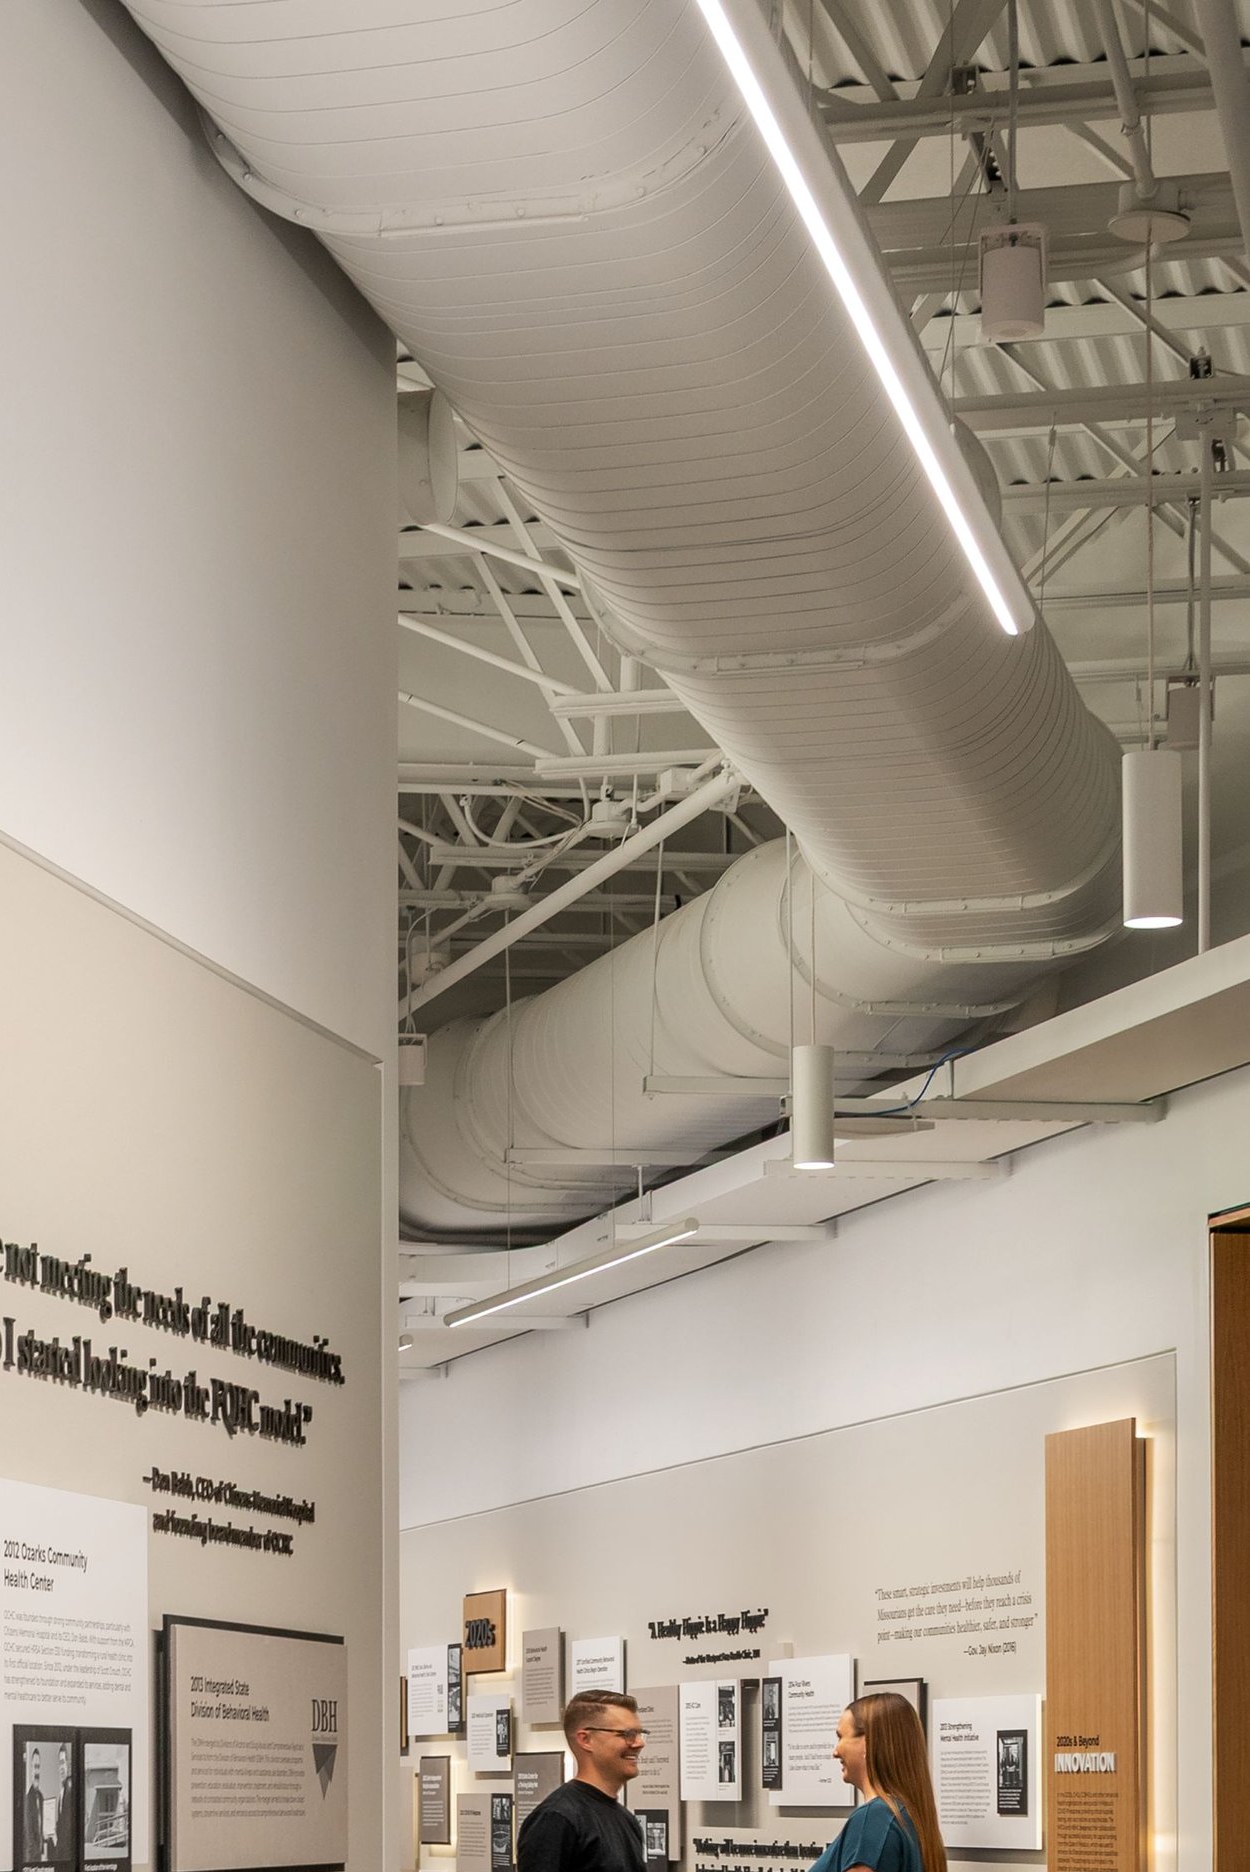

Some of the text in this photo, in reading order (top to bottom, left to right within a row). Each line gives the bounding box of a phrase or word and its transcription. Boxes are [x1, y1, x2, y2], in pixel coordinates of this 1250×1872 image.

[4, 1243, 40, 1288] not
[40, 1254, 112, 1322] meeting
[114, 1267, 143, 1322] the
[143, 1287, 190, 1337] needs
[192, 1297, 211, 1343] of
[211, 1302, 230, 1350] all
[231, 1309, 257, 1358] the
[3, 1317, 16, 1371] I
[17, 1329, 82, 1389] started
[82, 1339, 149, 1416] looking
[149, 1358, 182, 1415] into
[183, 1371, 210, 1421] the
[210, 1378, 259, 1438] FQHC
[4, 1540, 87, 1573] 2012 Ozarks Community
[4, 1569, 54, 1591] Health Center
[909, 1583, 932, 1597] strategic
[929, 1581, 963, 1594] investments
[962, 1576, 974, 1590] will
[973, 1576, 987, 1590] help
[986, 1572, 1016, 1587] thousands
[464, 1618, 496, 1649] 2020s
[977, 1644, 989, 1657] Jay
[986, 1643, 1004, 1655] Nixon
[205, 1678, 249, 1697] Integrated State
[191, 1701, 216, 1718] Division
[222, 1704, 250, 1720] Behavioral
[252, 1706, 269, 1721] Health
[311, 1699, 337, 1732] DBH
[1078, 1735, 1100, 1747] Beyond
[1054, 1752, 1116, 1773] INNOVATION
